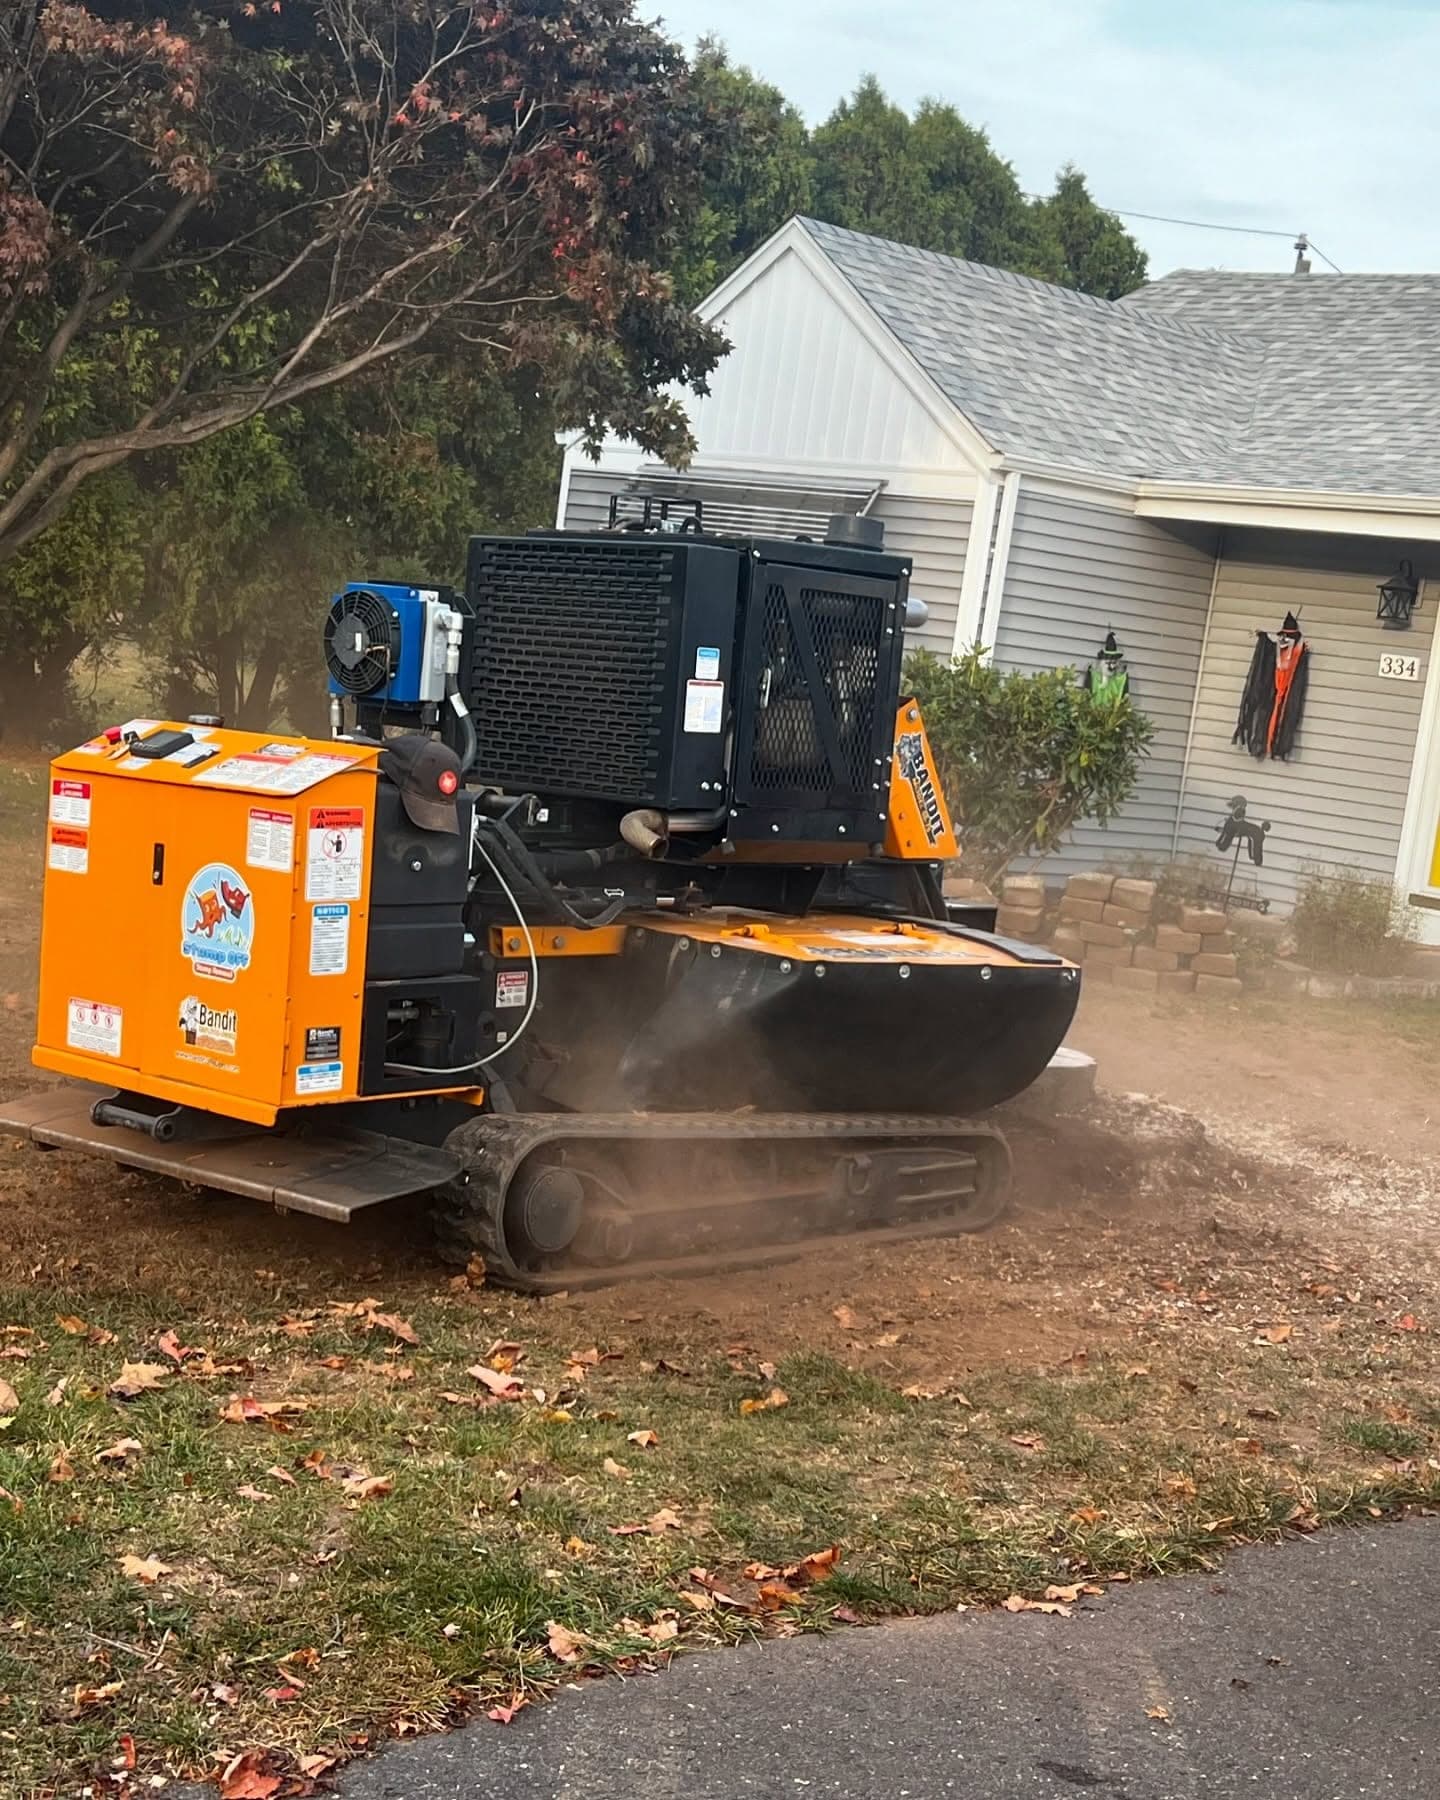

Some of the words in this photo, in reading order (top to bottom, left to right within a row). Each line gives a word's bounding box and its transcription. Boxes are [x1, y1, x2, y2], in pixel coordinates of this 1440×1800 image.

[1381, 656, 1416, 677] 334
[914, 753, 945, 836] BANDIT
[199, 1003, 236, 1032] Bandit
